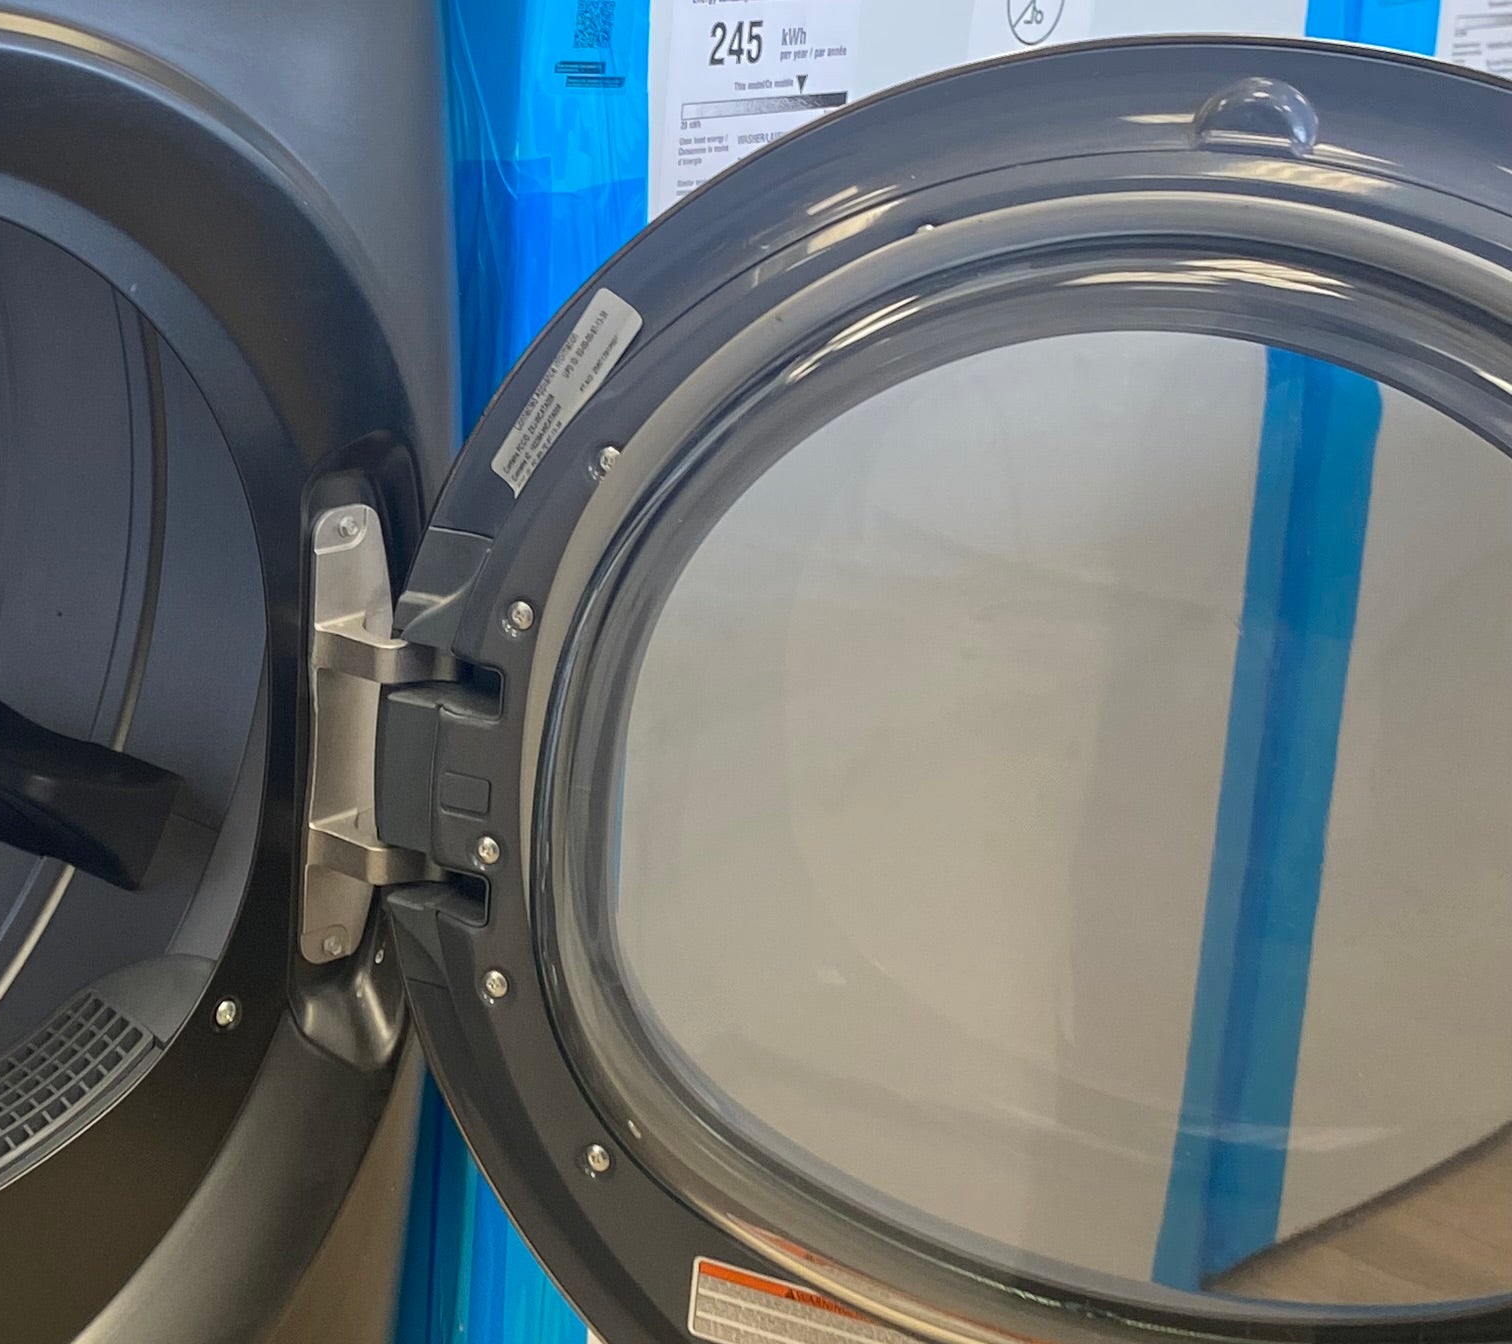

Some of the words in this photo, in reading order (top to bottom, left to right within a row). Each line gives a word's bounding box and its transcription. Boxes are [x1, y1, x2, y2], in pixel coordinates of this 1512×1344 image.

[709, 20, 764, 66] 245
[781, 27, 807, 46] kWh
[780, 50, 792, 62] per
[793, 49, 808, 61] year
[814, 48, 825, 59] par
